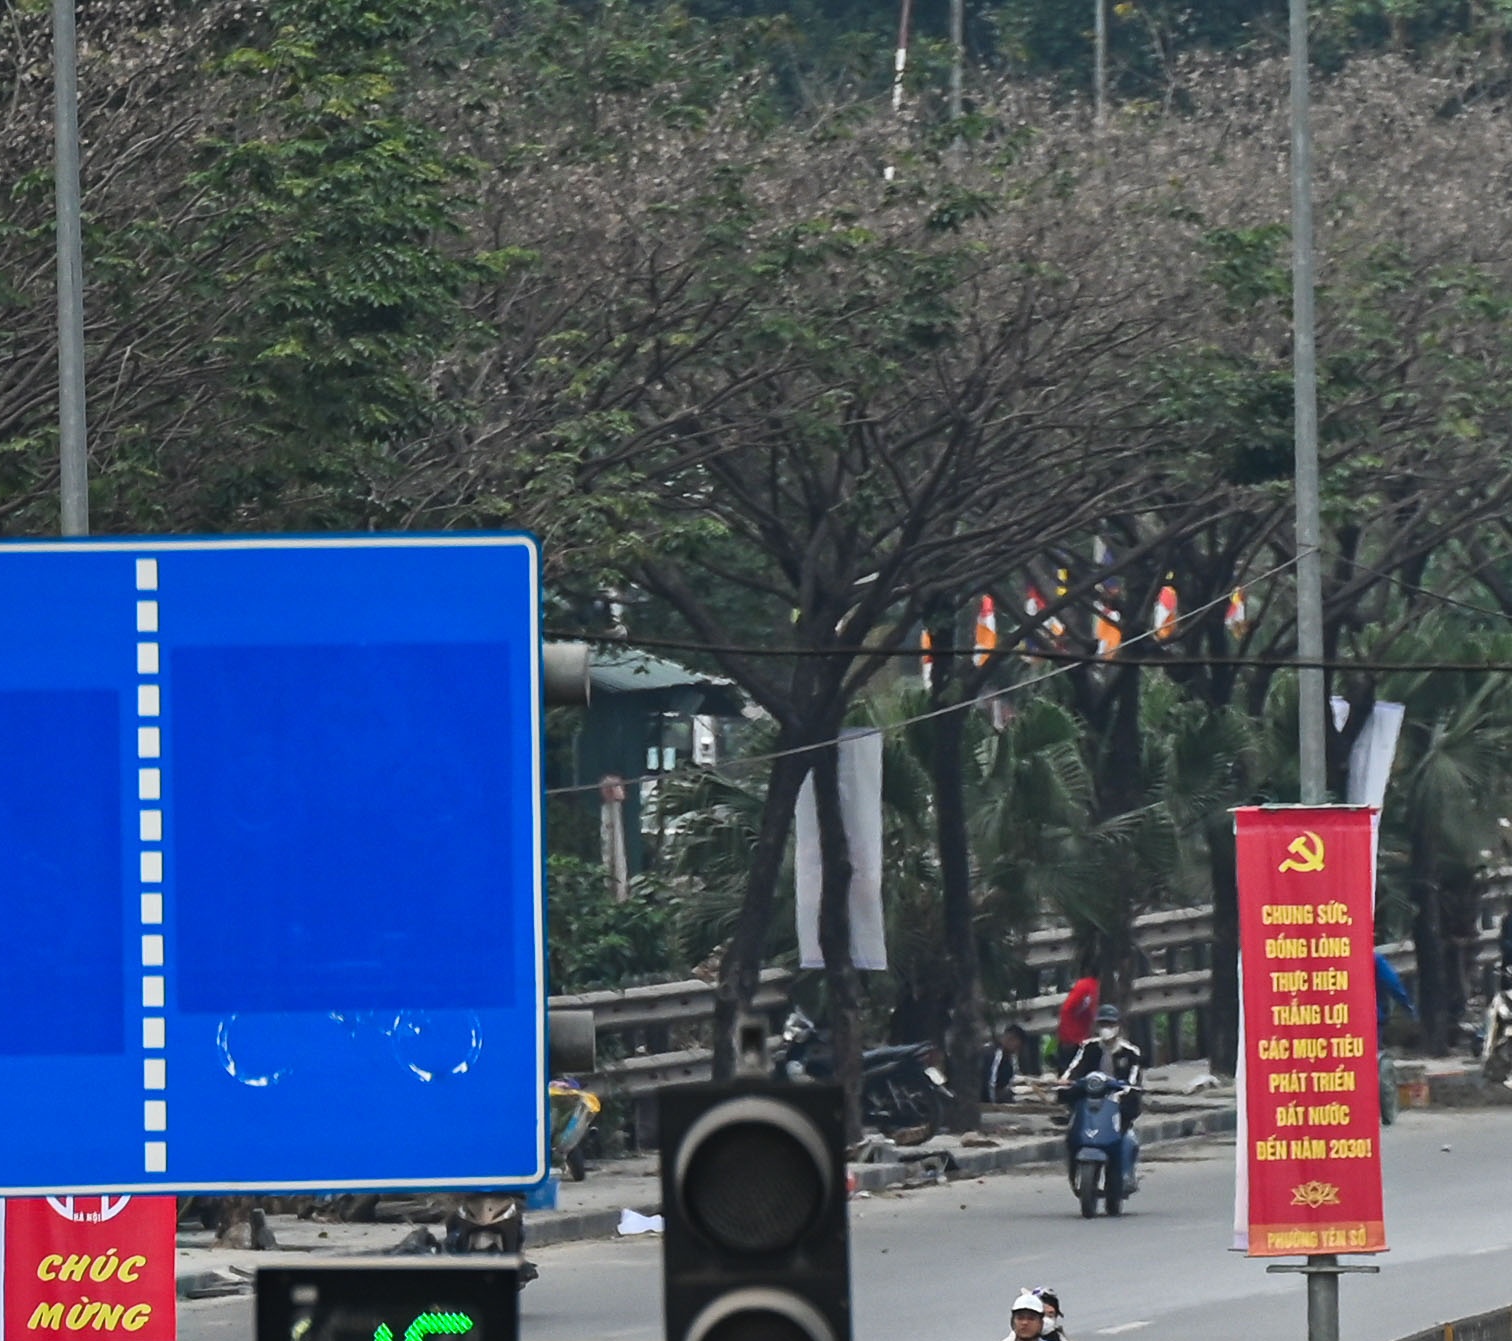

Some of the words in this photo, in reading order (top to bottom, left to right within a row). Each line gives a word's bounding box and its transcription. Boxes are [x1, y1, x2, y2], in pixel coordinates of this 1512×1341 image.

[1262, 904, 1313, 925] CHUNG
[1317, 900, 1352, 926] SỨC,
[1266, 932, 1307, 959] ĐỒNG
[1311, 935, 1350, 958] LÒNG
[1270, 971, 1308, 997] THỰC
[1313, 967, 1348, 995] HIỆN
[1272, 999, 1320, 1025] THẮNG
[1325, 1004, 1348, 1029] LỢI
[1258, 1037, 1289, 1059] CÁC
[1293, 1040, 1327, 1064] MỤC
[1332, 1034, 1363, 1058] TIÊU
[1269, 1069, 1307, 1093] PHÁT
[1312, 1065, 1354, 1091] TRIỂN
[1276, 1102, 1304, 1126] ĐẤT
[1309, 1103, 1349, 1125] NƯỚC
[1256, 1135, 1287, 1160] ĐẾN
[1291, 1135, 1326, 1160] NĂM
[1330, 1138, 1371, 1158] 2030!
[37, 1249, 146, 1284] CHÚC
[28, 1297, 151, 1331] MỪNG
